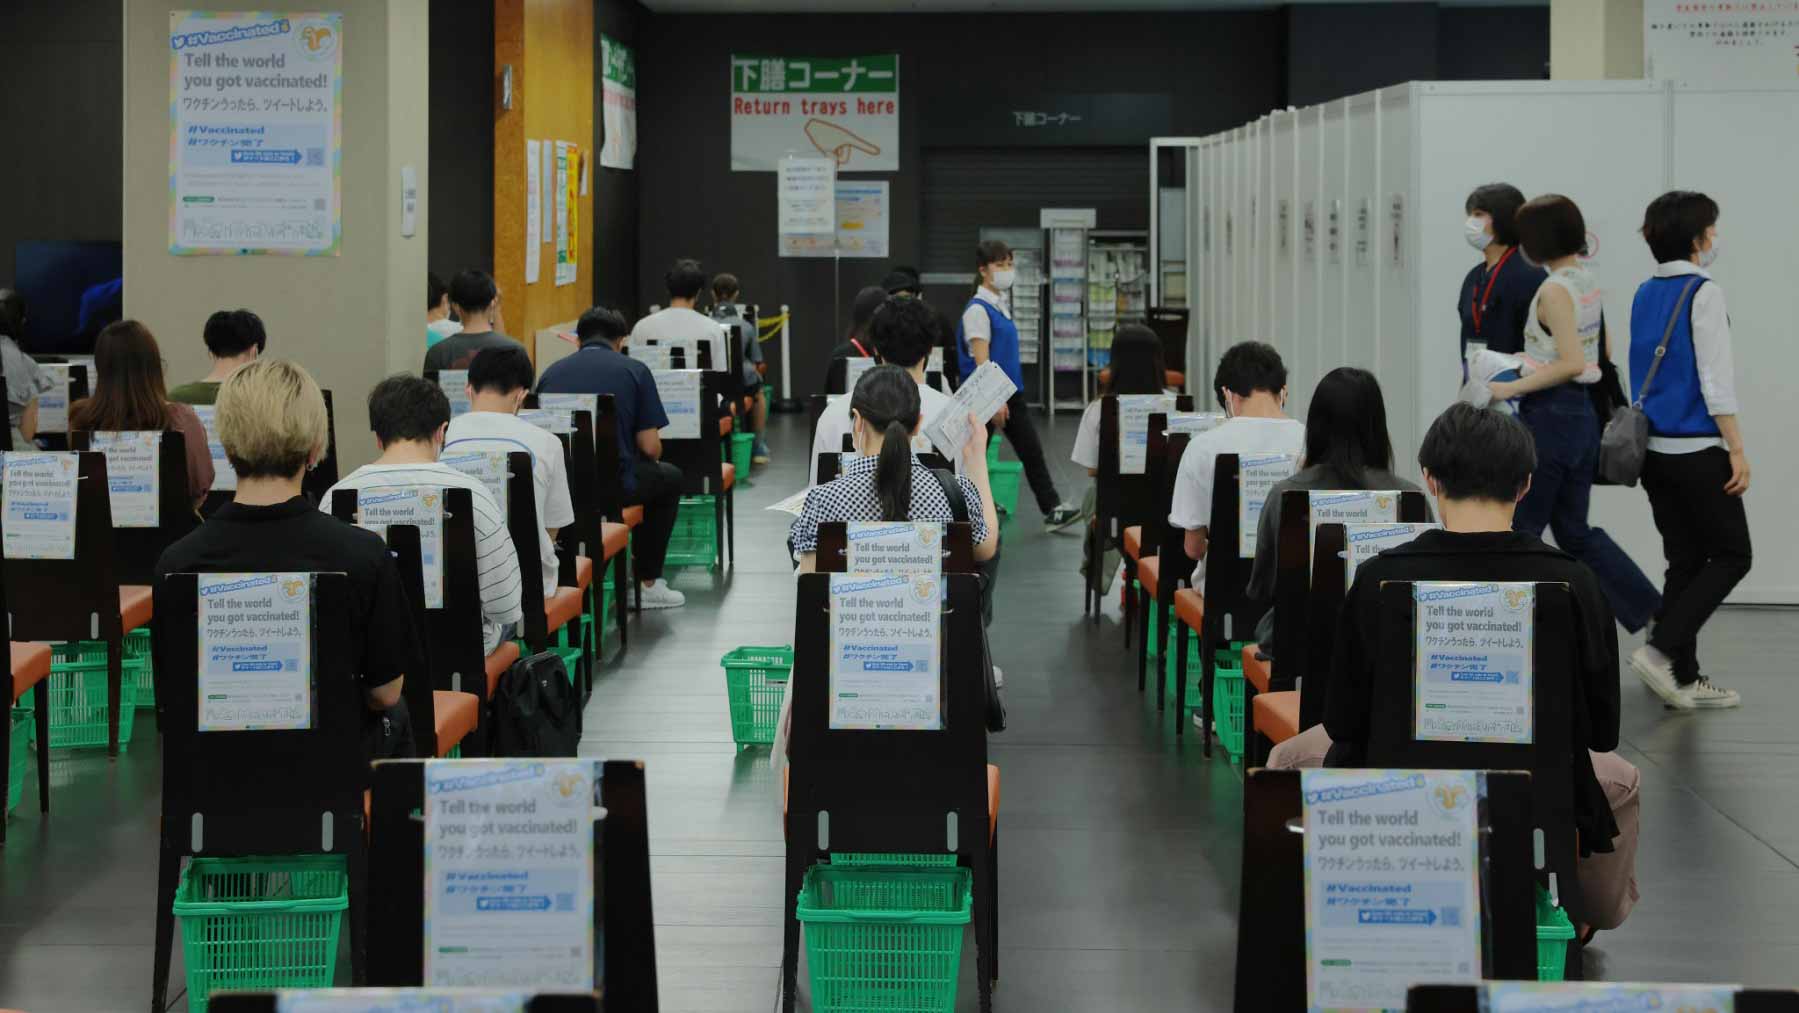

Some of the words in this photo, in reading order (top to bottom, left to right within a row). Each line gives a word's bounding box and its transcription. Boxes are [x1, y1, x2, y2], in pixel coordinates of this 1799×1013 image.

[187, 20, 279, 46] #Vaccinated
[184, 53, 210, 68] Tell
[215, 53, 239, 68] the
[243, 53, 285, 68] world
[732, 58, 894, 92] 下膳コーナー
[184, 75, 212, 90] you
[216, 75, 242, 91] got
[246, 73, 328, 88] vaccinated!
[734, 97, 791, 115] Return
[801, 97, 848, 116] trays
[857, 97, 895, 115] here
[188, 125, 265, 135] #Vaccinated
[383, 507, 392, 516] the
[392, 507, 414, 516] world
[1316, 509, 1332, 517] Tell
[1333, 509, 1345, 517] the
[1345, 509, 1368, 518] world
[855, 543, 870, 552] Tell
[871, 543, 884, 552] the
[887, 543, 910, 553] world
[1355, 545, 1370, 554] Tell
[855, 556, 870, 565] you
[872, 556, 886, 566] got
[888, 555, 932, 564] vaccinated!
[208, 599, 224, 609] Tell
[227, 598, 242, 609] the
[244, 597, 272, 609] world
[840, 597, 856, 608] Tell
[859, 597, 873, 608] the
[876, 597, 904, 608] world
[208, 615, 225, 625] you
[227, 613, 244, 625] got
[246, 611, 300, 622] vaccinated!
[840, 613, 857, 624] you
[859, 612, 876, 624] got
[878, 611, 931, 622] vaccinated!
[1425, 606, 1444, 617] Tell
[1447, 606, 1463, 617] the
[1465, 607, 1494, 618] world
[1426, 622, 1444, 632] you
[1447, 622, 1464, 633] got
[1466, 621, 1521, 633] vaccinated!
[439, 800, 465, 814] Tell
[468, 800, 490, 814] the
[496, 800, 536, 814] world
[1317, 810, 1344, 825] Tell
[1348, 809, 1372, 825] the
[1375, 809, 1418, 825] world
[439, 824, 467, 839] you
[469, 823, 494, 839] got
[498, 820, 577, 834] vaccinated!
[1318, 833, 1345, 849] you
[1350, 832, 1375, 850] got
[1378, 831, 1462, 847] vaccinated!
